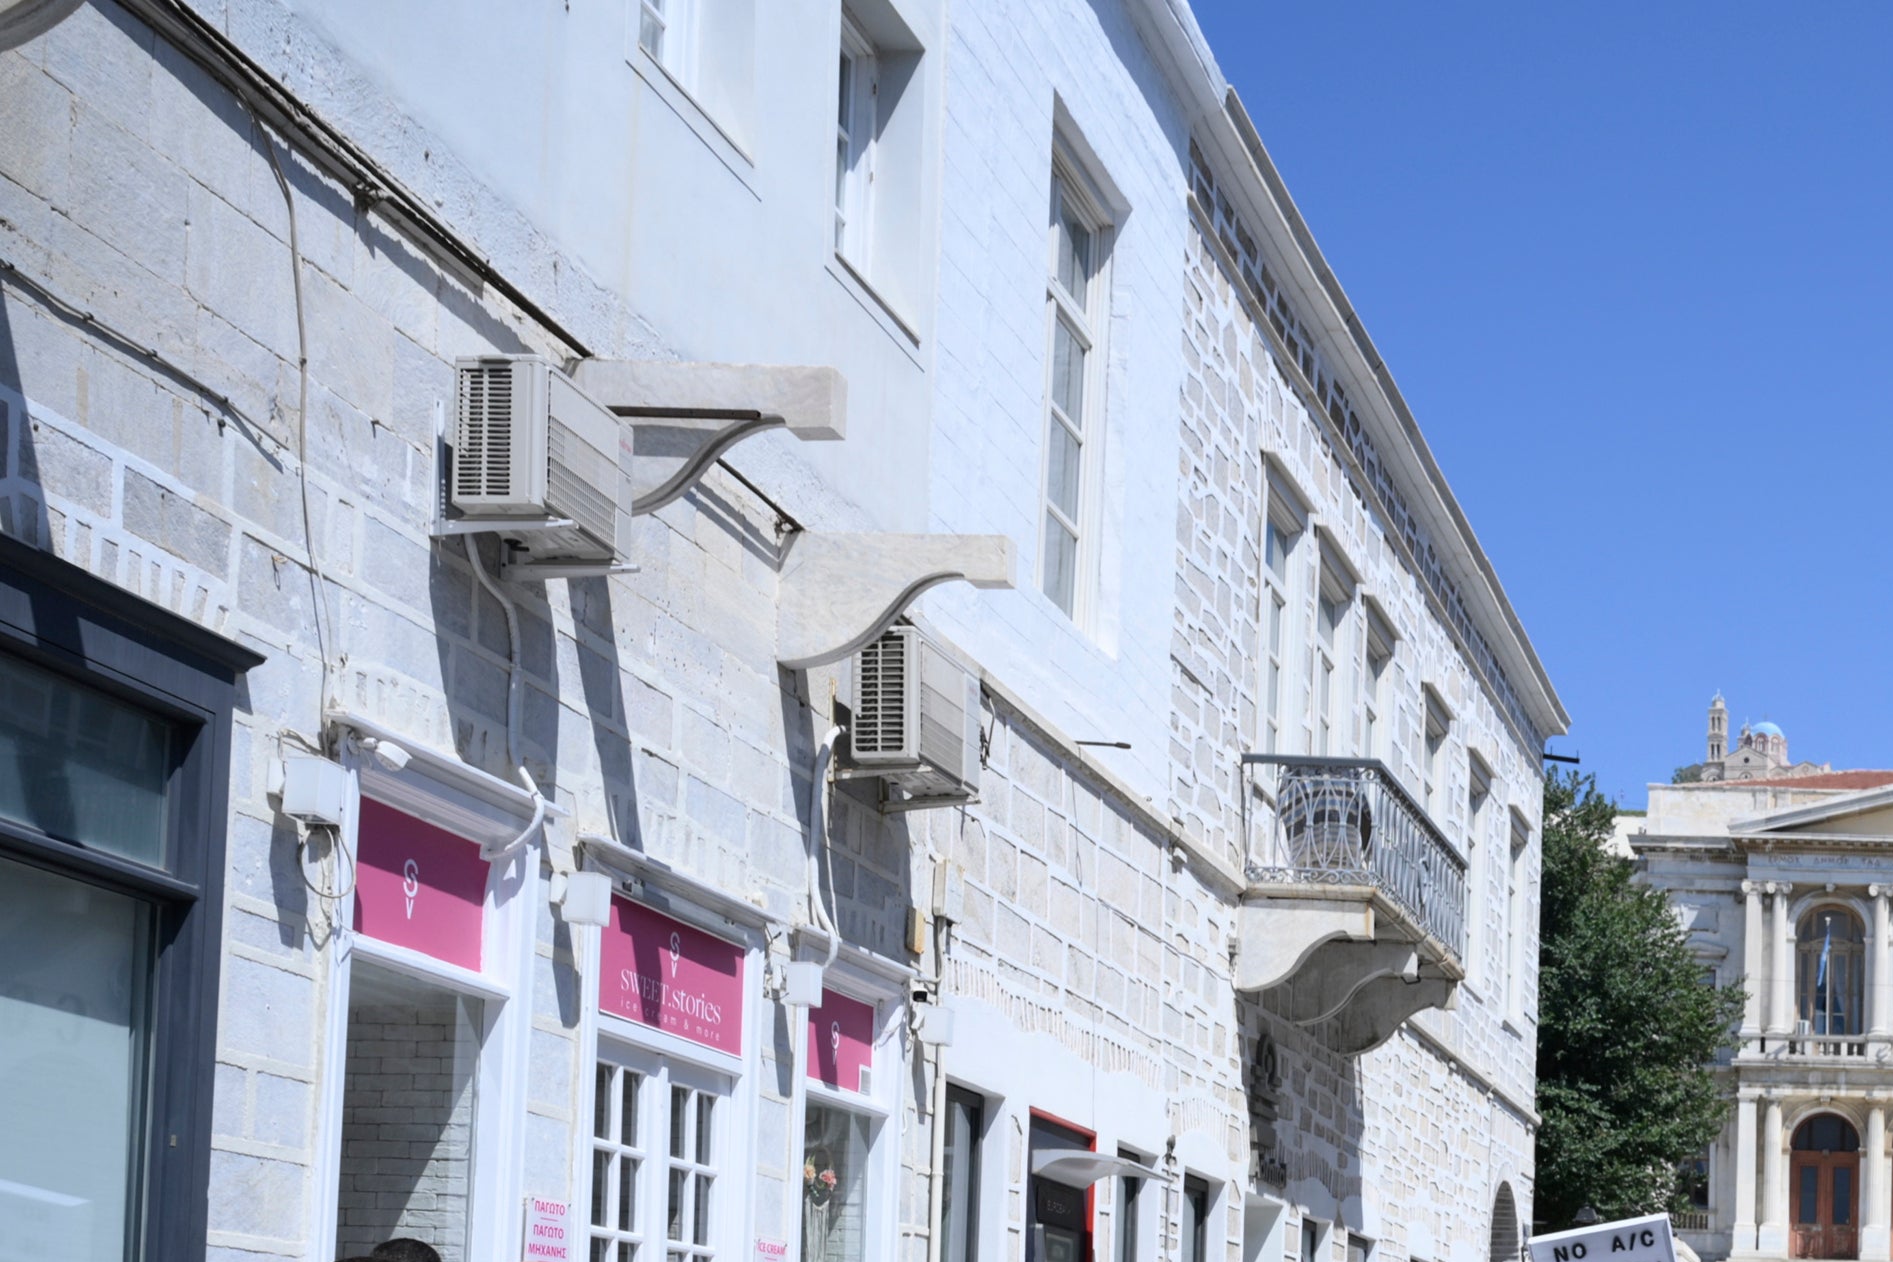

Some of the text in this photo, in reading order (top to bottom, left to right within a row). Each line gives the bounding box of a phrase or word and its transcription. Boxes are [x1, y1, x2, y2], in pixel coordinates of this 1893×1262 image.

[620, 996, 720, 1041] ice cream & more
[534, 1200, 566, 1216] ΠΑΓΩΤΟ
[533, 1224, 564, 1239] ΠΑΓΩΤΟ
[528, 1242, 567, 1259] ΜΗΧΑΝΗΣ
[767, 1243, 785, 1256] CREAM
[1553, 1229, 1655, 1262] NO A/C
